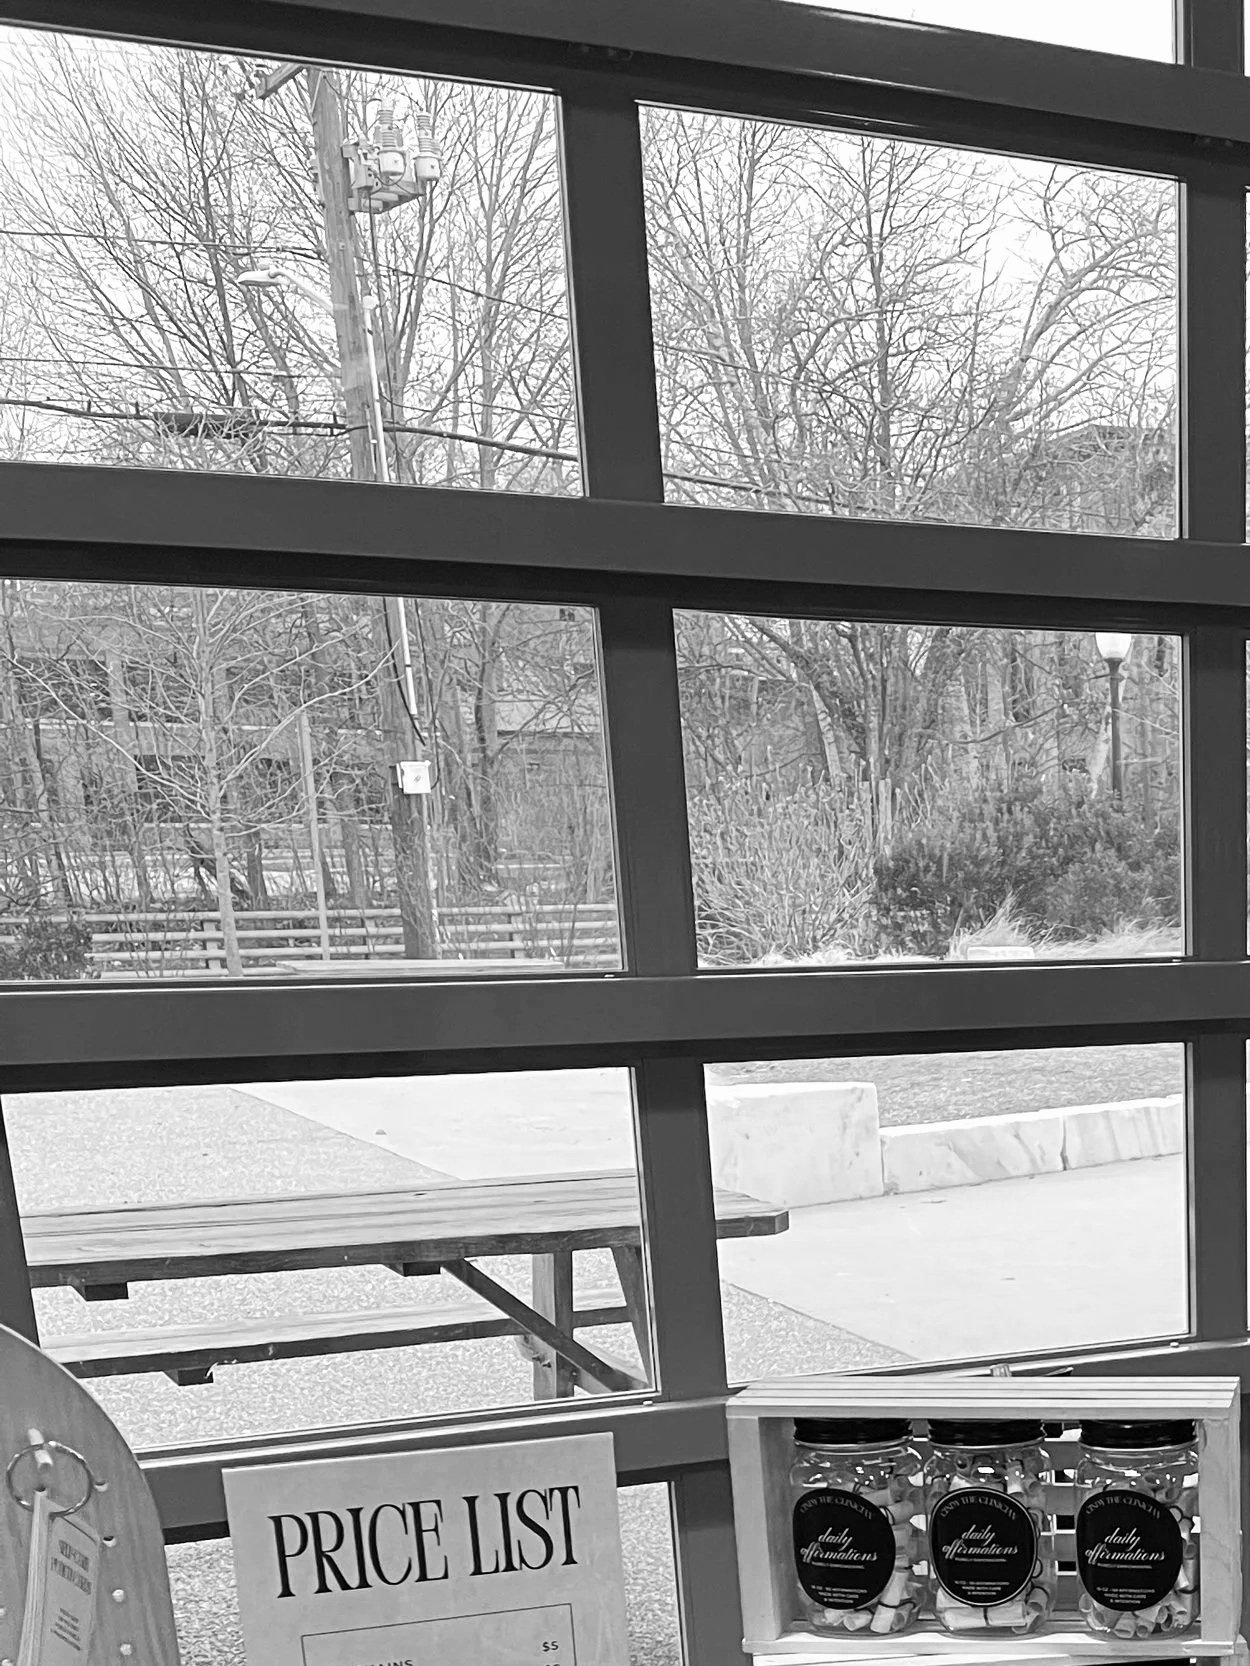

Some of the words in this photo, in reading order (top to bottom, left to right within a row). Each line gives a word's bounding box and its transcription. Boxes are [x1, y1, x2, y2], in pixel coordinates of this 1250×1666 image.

[266, 1499, 449, 1599] PRICE
[461, 1485, 581, 1577] LIST
[817, 1526, 853, 1552] daily
[961, 1524, 996, 1547] daily
[1104, 1527, 1141, 1552] daily
[800, 1541, 878, 1564] affirmations
[942, 1539, 1019, 1560] affirmations
[1084, 1542, 1165, 1566] affirmations
[541, 1640, 560, 1652] $5
